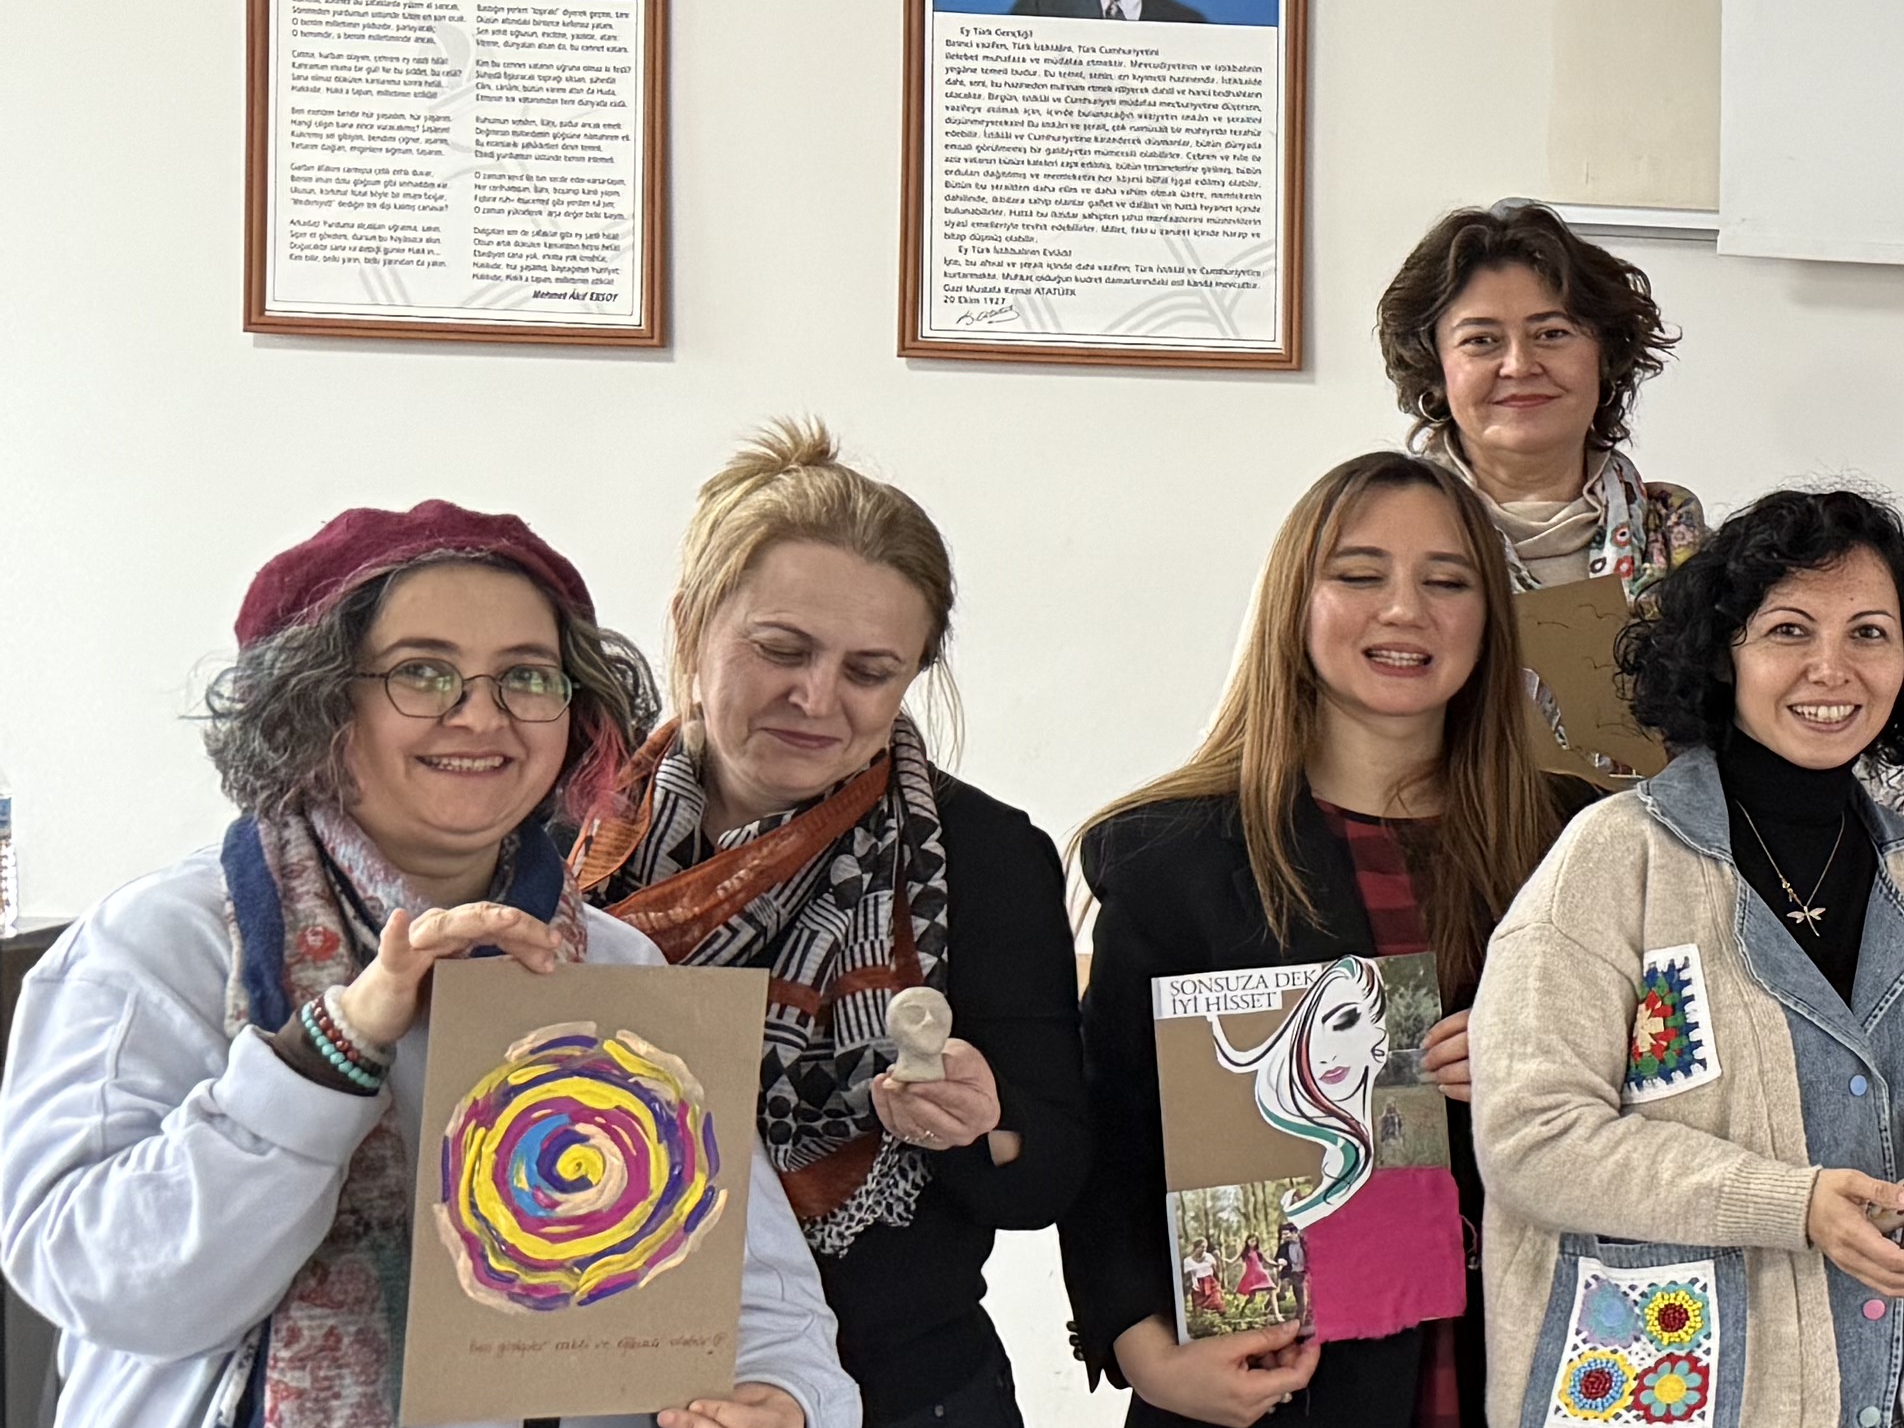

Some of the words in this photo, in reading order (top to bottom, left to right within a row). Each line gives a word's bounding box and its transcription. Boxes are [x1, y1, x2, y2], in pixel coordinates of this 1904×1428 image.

[1170, 974, 1269, 998] SONSUZA
[1274, 969, 1317, 988] DEK
[1171, 994, 1199, 1015] İYİ
[1206, 991, 1277, 1012] HİSSET
